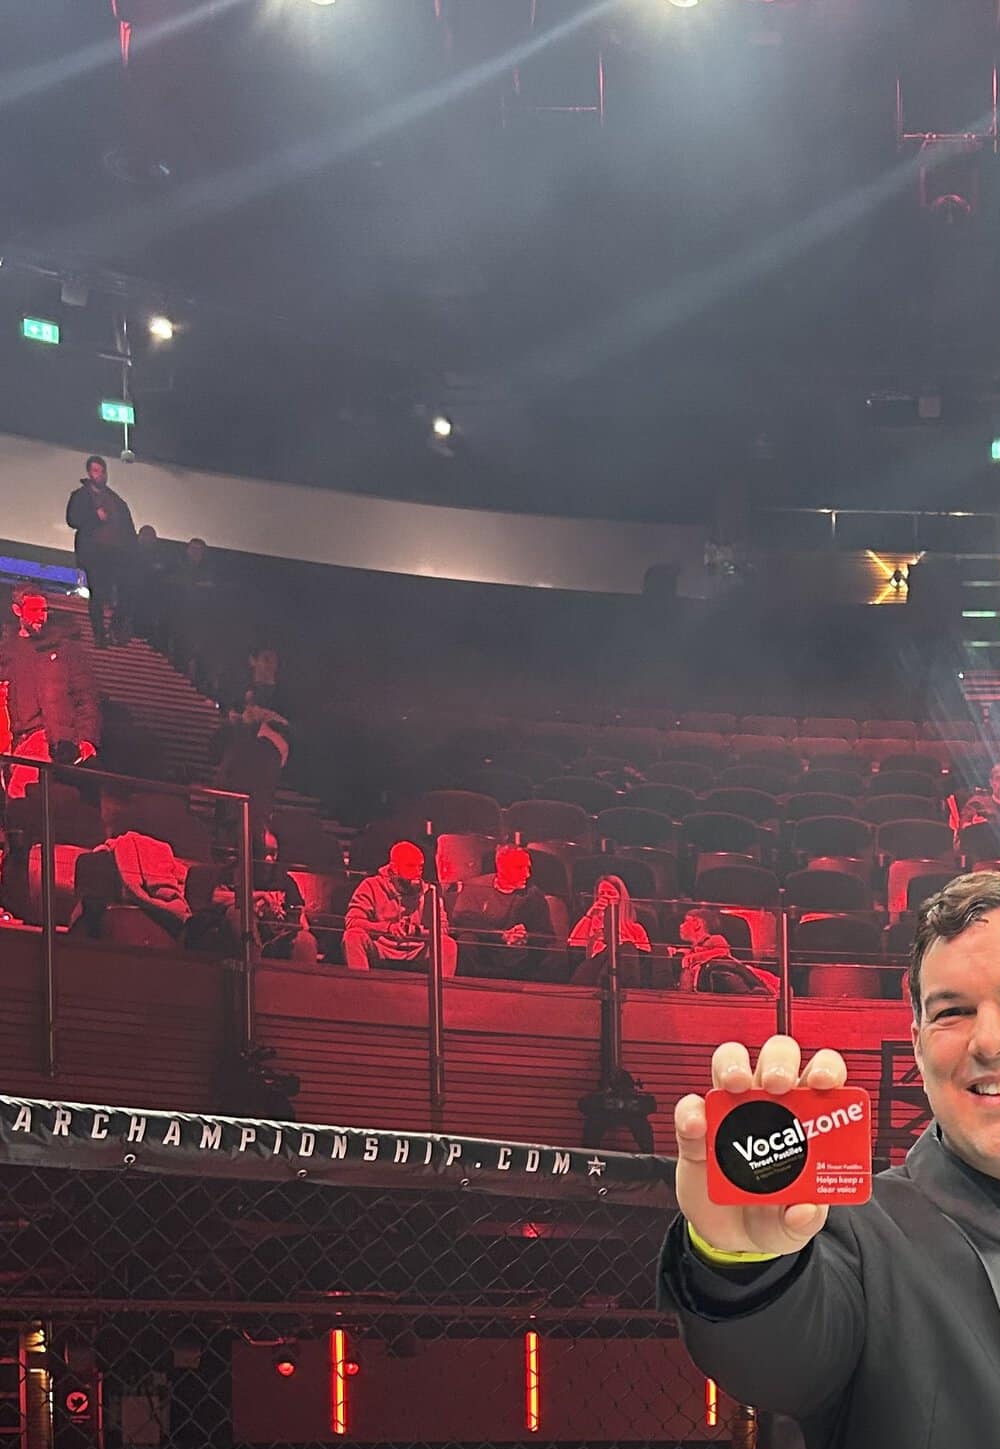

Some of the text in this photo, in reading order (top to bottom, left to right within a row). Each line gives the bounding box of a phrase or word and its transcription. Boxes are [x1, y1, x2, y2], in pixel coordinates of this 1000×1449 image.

[732, 1103, 864, 1161] Vocalzone
[749, 1156, 774, 1170] Throat
[816, 1175, 838, 1185] Helps
[839, 1175, 857, 1185] keep
